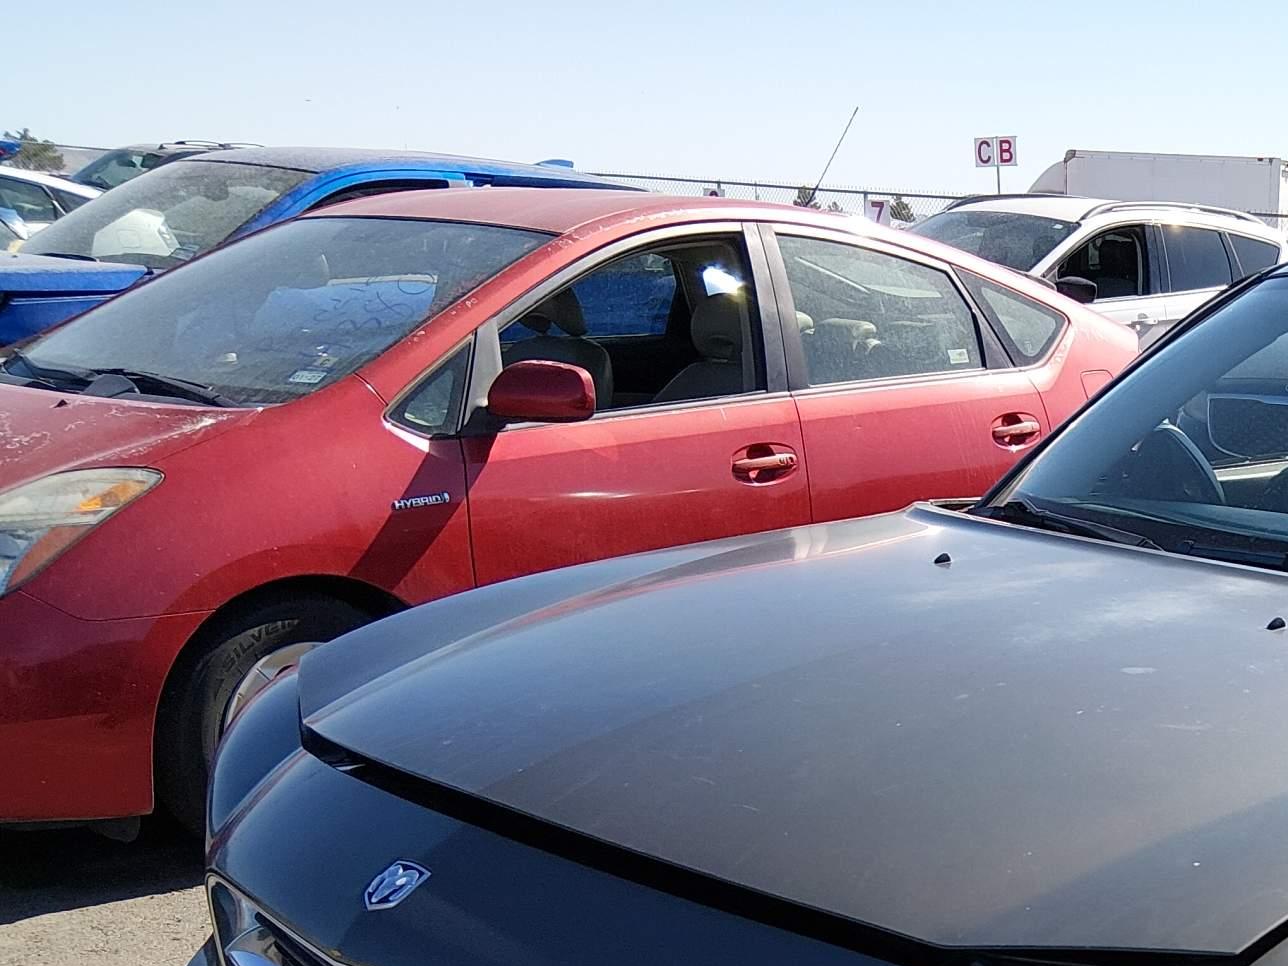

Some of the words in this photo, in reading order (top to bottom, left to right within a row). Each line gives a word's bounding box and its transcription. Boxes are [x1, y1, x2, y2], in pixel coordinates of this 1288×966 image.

[977, 140, 991, 164] C
[999, 139, 1013, 163] B
[870, 201, 888, 223] 7
[394, 495, 443, 510] HYBRID
